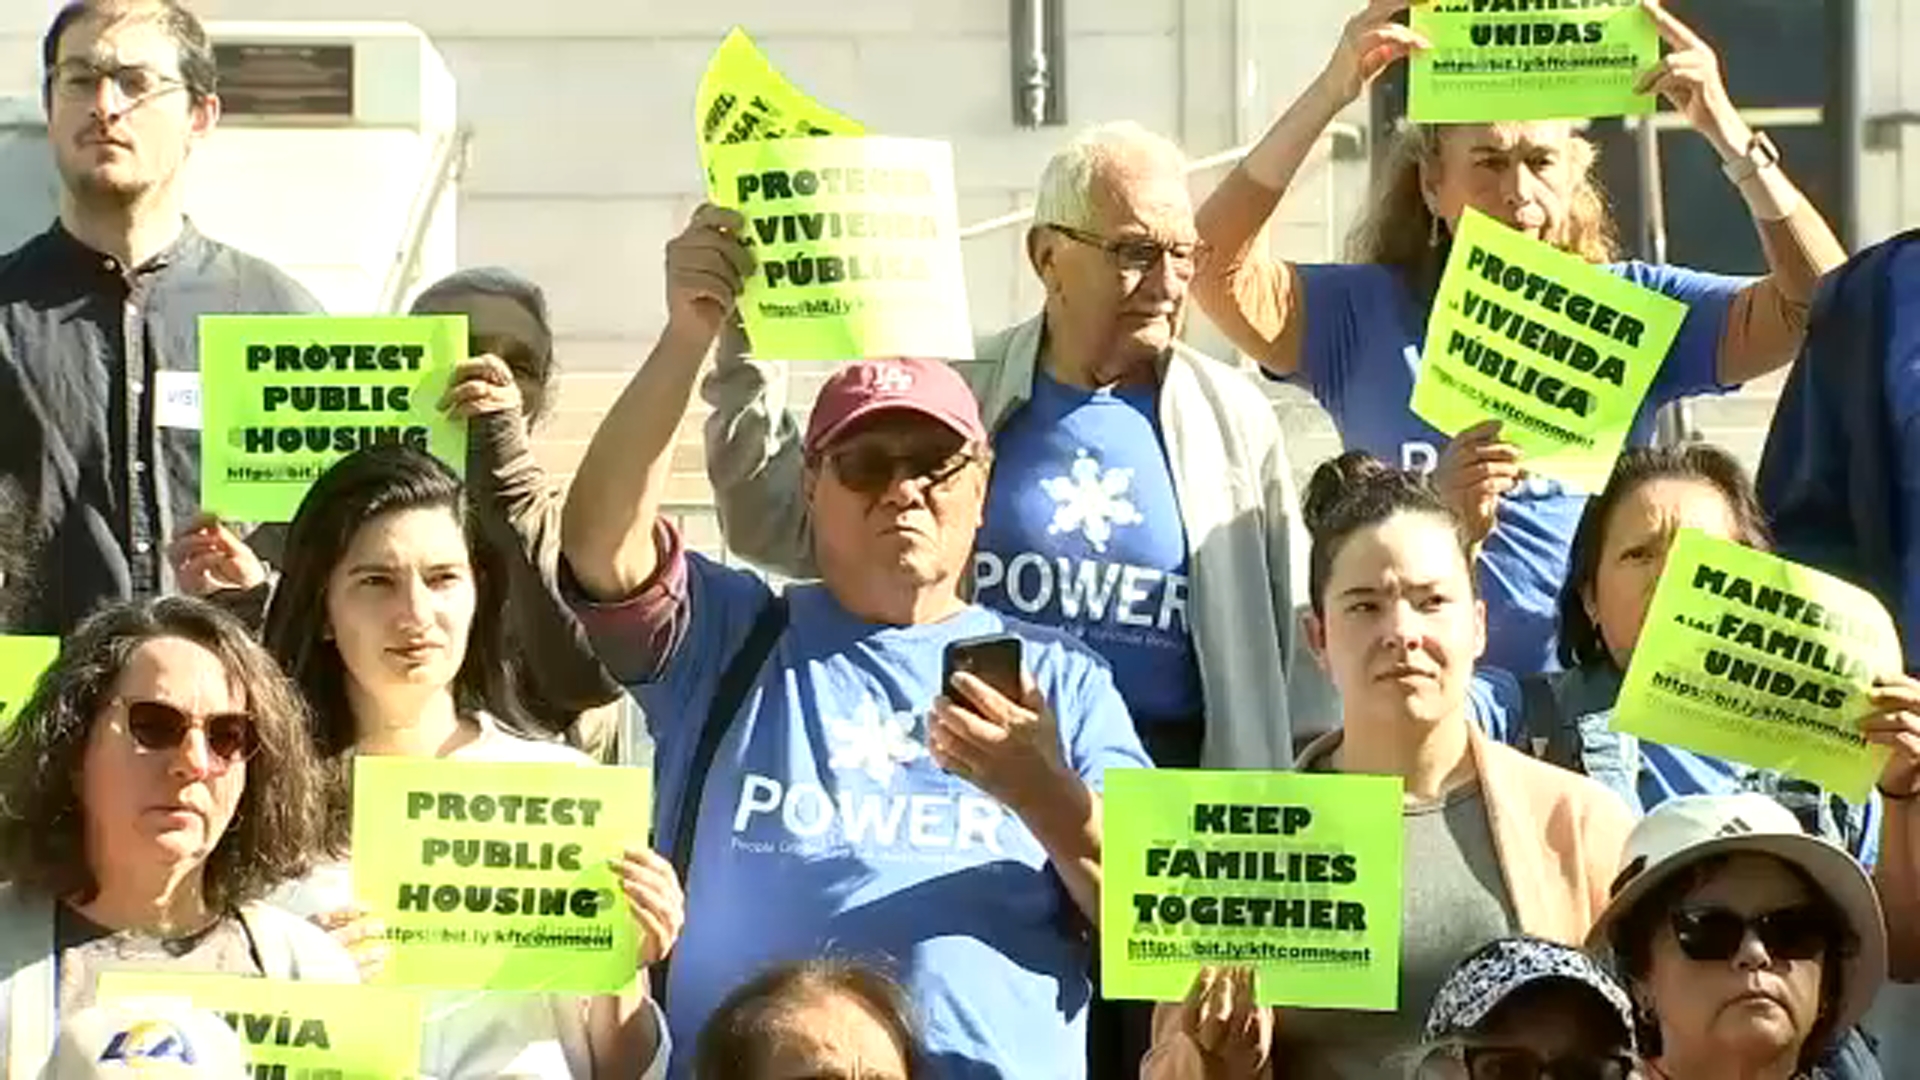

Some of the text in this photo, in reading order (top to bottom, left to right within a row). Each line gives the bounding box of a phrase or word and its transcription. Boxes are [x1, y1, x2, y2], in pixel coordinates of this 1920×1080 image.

[1470, 22, 1604, 46] UNIDAS
[1467, 245, 1645, 348] PROTEGER
[1462, 289, 1626, 387] VIVIENDA
[246, 344, 424, 371] PROTECT
[1447, 330, 1590, 418] PÚBLICA
[263, 386, 411, 411] PUBLIC
[244, 426, 428, 453] HOUSING
[974, 552, 1188, 631] POWER
[1717, 613, 1871, 685] FAMILIA
[1704, 650, 1847, 710] UNIDAS
[407, 791, 602, 827] PROTECT
[733, 774, 1002, 854] POWER
[1194, 803, 1312, 835] KEEP
[422, 838, 583, 871] PUBLIC
[1146, 848, 1357, 883] FAMILIES
[397, 884, 599, 918] HOUSING
[1133, 893, 1367, 931] TOGETHER
